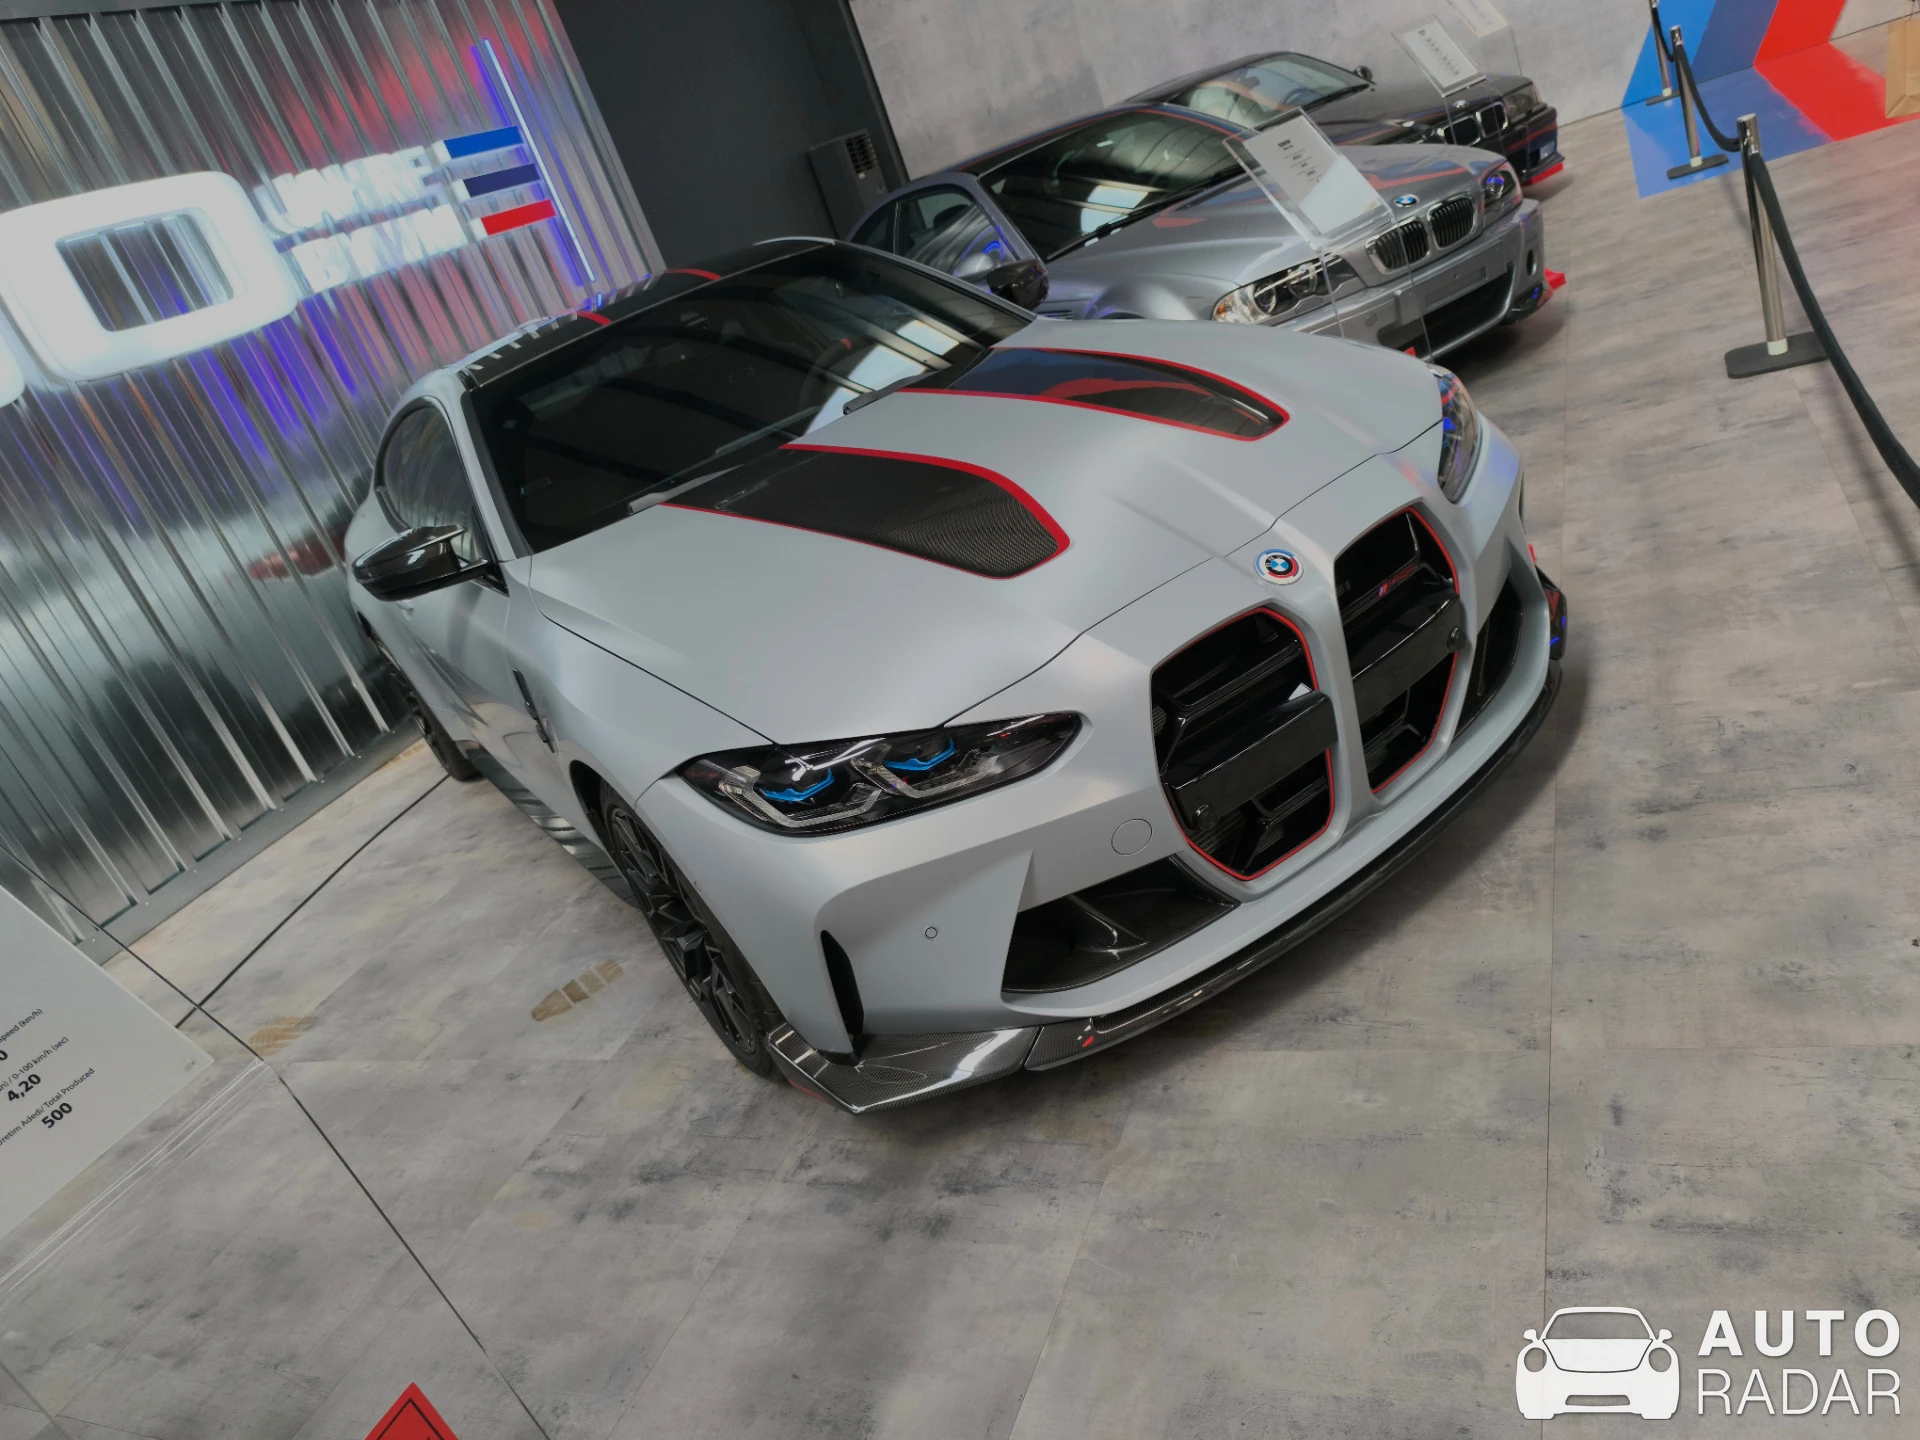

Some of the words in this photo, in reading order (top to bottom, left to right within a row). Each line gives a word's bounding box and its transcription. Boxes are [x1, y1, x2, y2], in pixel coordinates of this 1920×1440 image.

[0, 171, 299, 408] 0
[18, 1008, 43, 1027] (km/h)
[12, 1062, 34, 1079] 0-100
[32, 1048, 52, 1064] km/h
[51, 1036, 69, 1051] (sec)
[7, 1073, 41, 1101] 4,20
[43, 1092, 62, 1108] Total
[61, 1068, 95, 1095] Produced
[41, 1102, 72, 1129] 500
